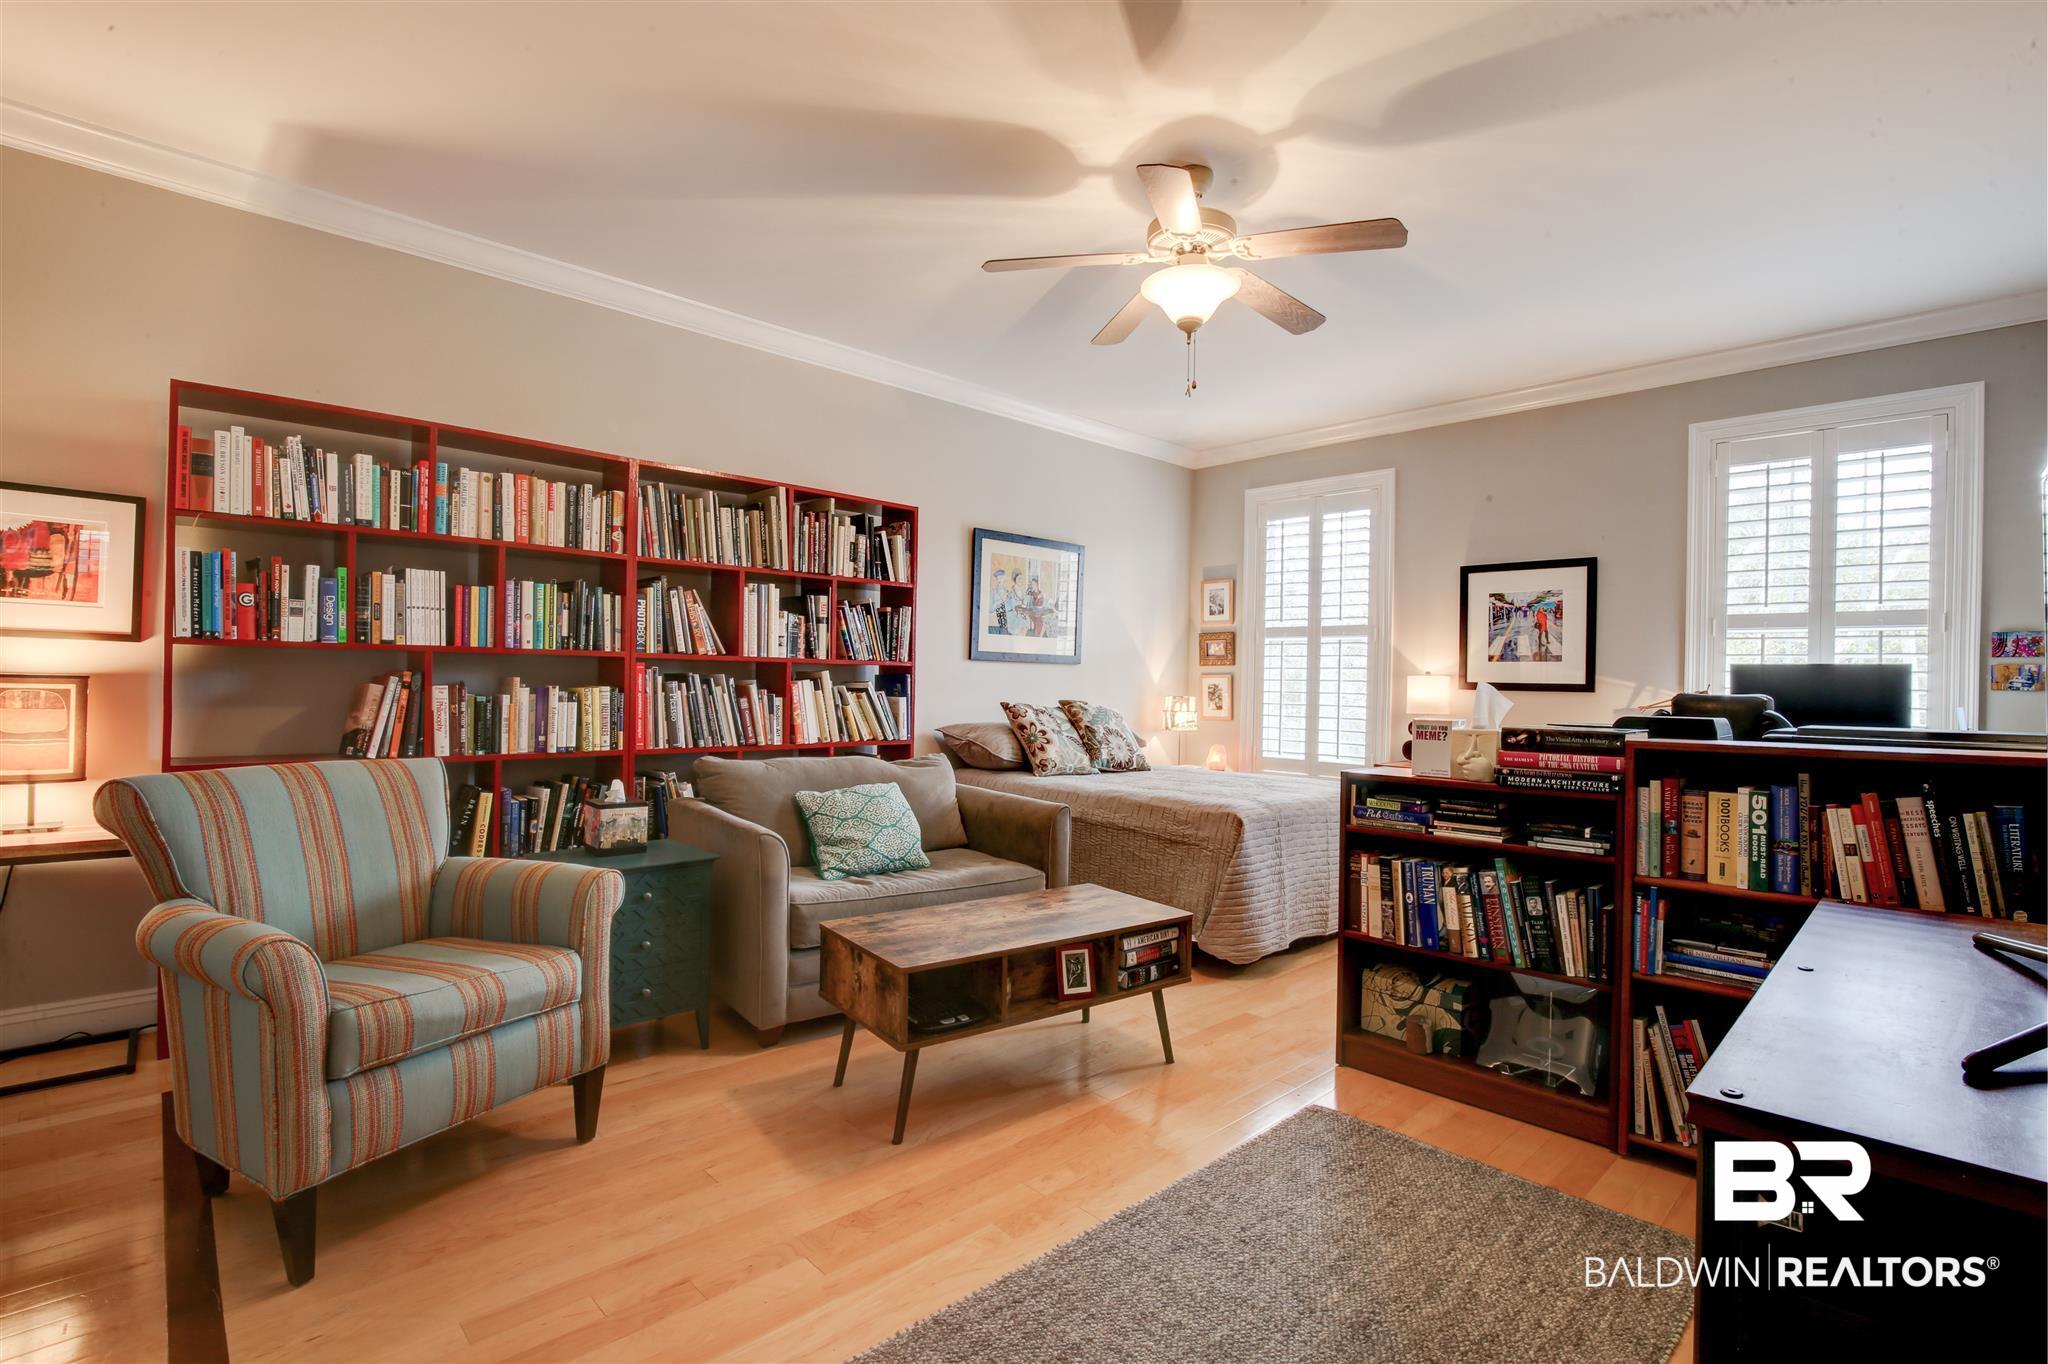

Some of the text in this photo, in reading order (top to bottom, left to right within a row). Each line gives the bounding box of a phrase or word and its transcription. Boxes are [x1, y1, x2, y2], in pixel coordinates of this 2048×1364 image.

[323, 595, 336, 626] Design
[436, 701, 444, 732] Philosophy
[669, 693, 678, 722] Picasso
[583, 721, 591, 752] Almighty
[1415, 730, 1448, 741] MEME?
[1589, 737, 1609, 745] History
[1538, 753, 1599, 763] PICTORIAL HISTORY
[1547, 761, 1559, 769] THE
[1573, 762, 1599, 771] CENTURY
[1507, 776, 1610, 788] MODERN ARCHITECTURE
[460, 799, 476, 824] BRAIN
[1751, 794, 1767, 835] 501
[1800, 795, 1808, 816] YOU
[1925, 800, 1941, 838] speeches
[476, 823, 486, 853] CODERS
[1737, 828, 1742, 836] TO
[1948, 816, 1967, 871] ON WRITING WELL
[2008, 823, 2024, 873] LITERATURE
[1421, 865, 1436, 905] TRUMAN
[1462, 901, 1476, 944] WILSON
[1489, 897, 1505, 950] EINSTEIN
[1137, 933, 1159, 944] AMERICAN
